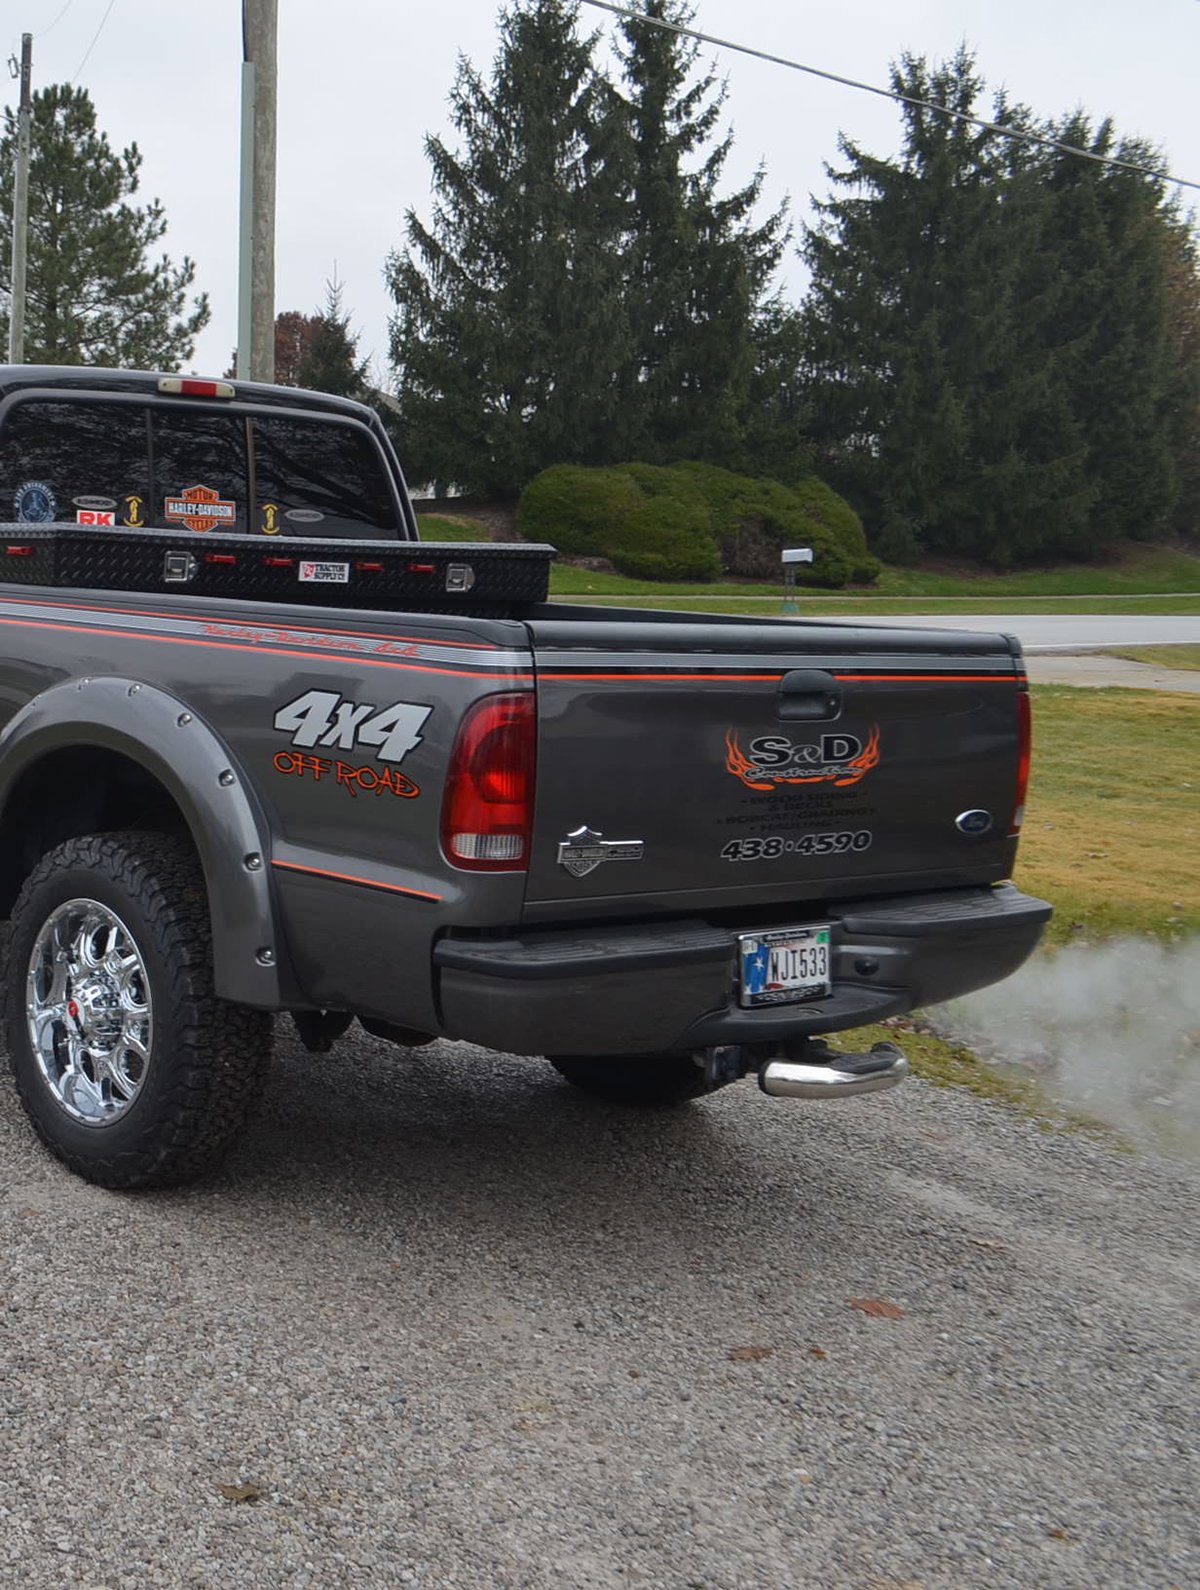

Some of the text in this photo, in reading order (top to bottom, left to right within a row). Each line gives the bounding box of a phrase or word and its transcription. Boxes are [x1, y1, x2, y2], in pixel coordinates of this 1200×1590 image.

[80, 511, 112, 526] RK
[168, 502, 232, 516] HARLEY-DAVIDSON
[750, 734, 862, 766] S&D
[274, 752, 420, 798] OFF ROAD
